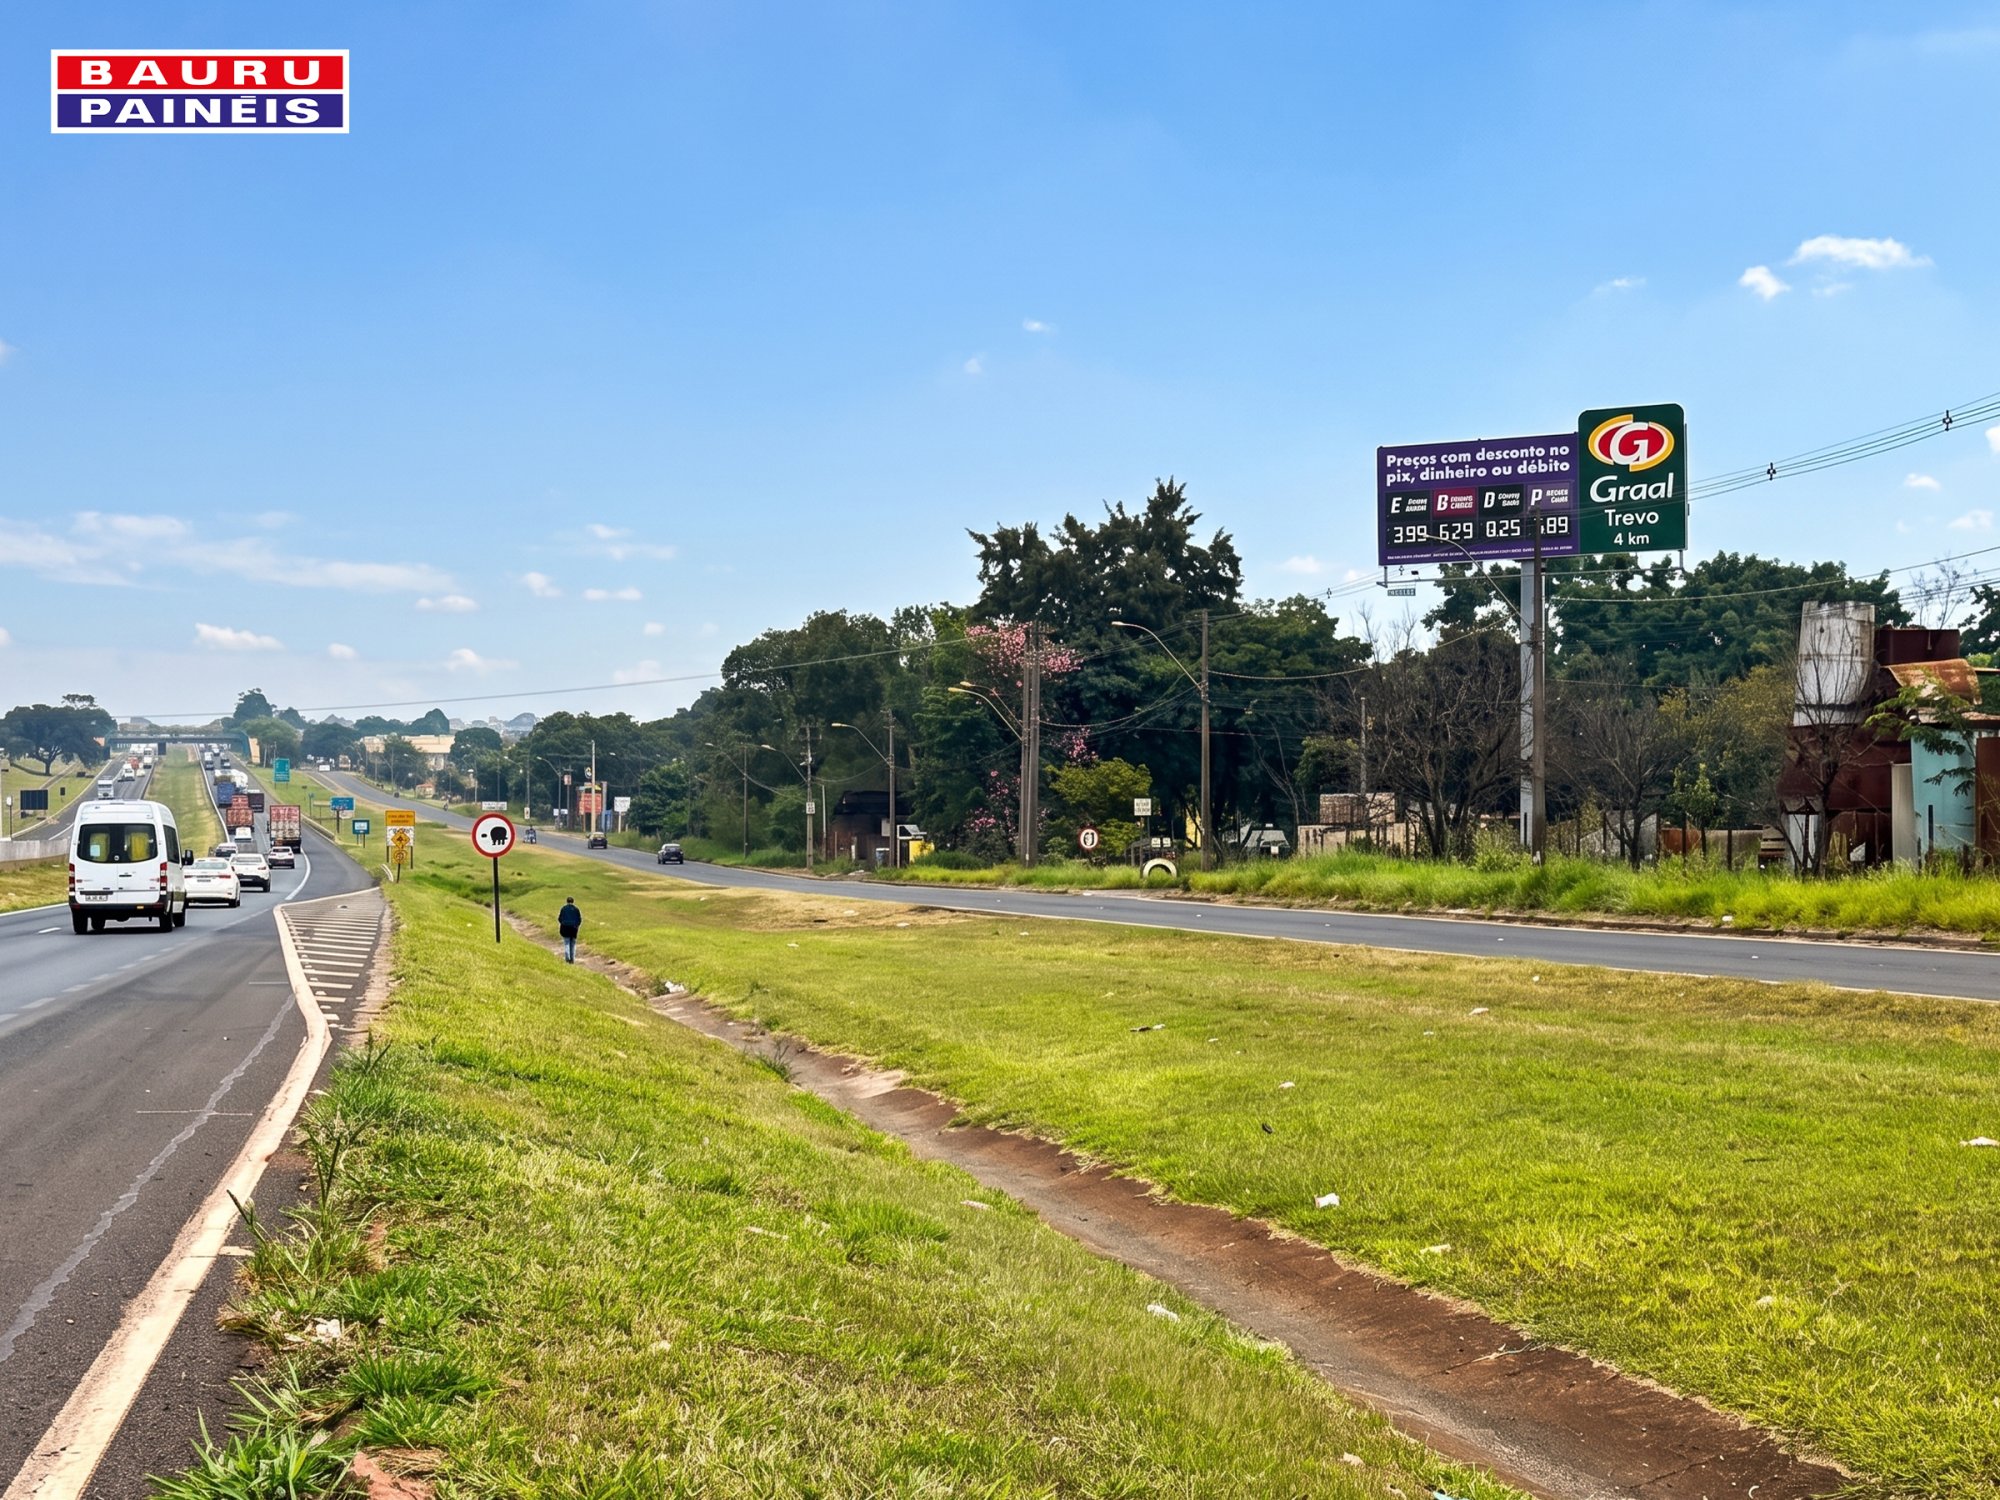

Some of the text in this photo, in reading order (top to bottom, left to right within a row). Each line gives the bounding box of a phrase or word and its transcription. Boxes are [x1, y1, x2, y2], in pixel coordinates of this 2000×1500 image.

[1386, 446, 1570, 469] Preços com desconto no
[1386, 460, 1570, 486] pix, dinheiro ou débito
[1589, 472, 1674, 503] Graal
[1391, 497, 1402, 514] E
[1437, 494, 1449, 511] B
[1484, 492, 1496, 508] D
[1530, 489, 1542, 506] P
[1604, 509, 1659, 526] Trevo
[1613, 531, 1650, 545] 4 km
